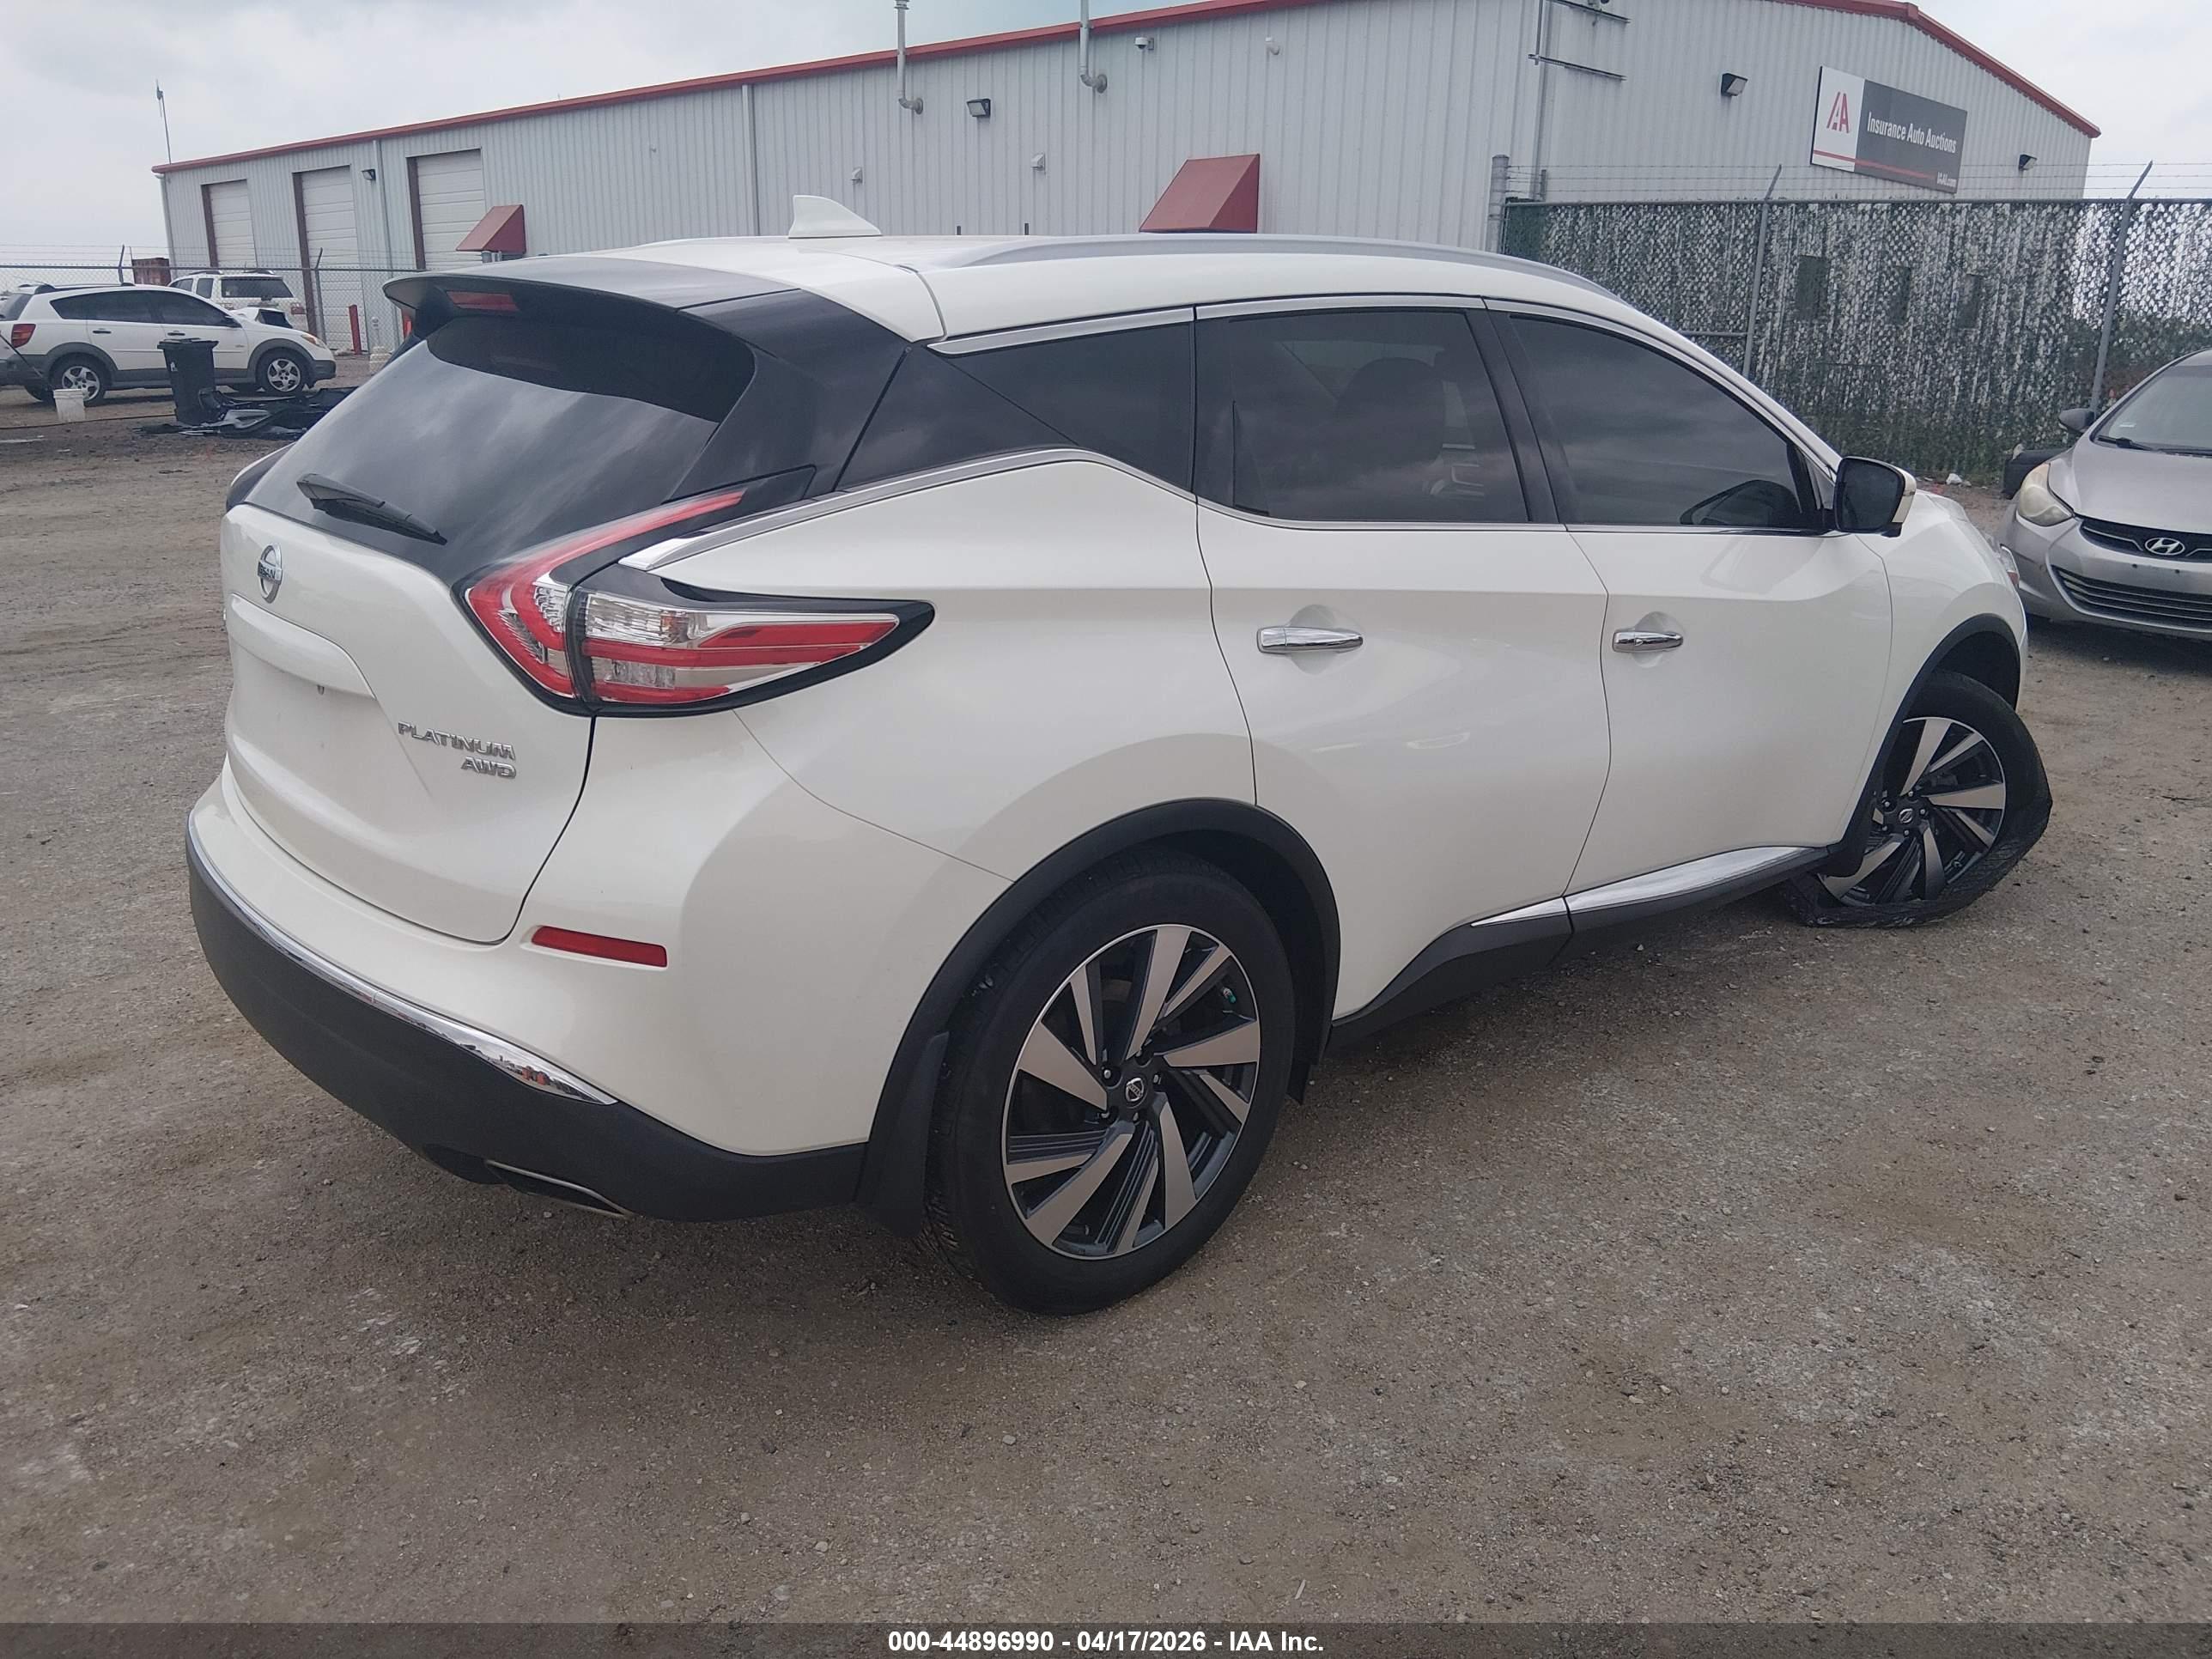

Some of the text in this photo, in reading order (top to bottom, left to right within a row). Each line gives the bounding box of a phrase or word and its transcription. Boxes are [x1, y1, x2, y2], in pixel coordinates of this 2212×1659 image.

[1867, 112, 1957, 154] Insurance Auto Auctions
[398, 721, 516, 761] PLATINUM
[460, 757, 517, 779] AWD
